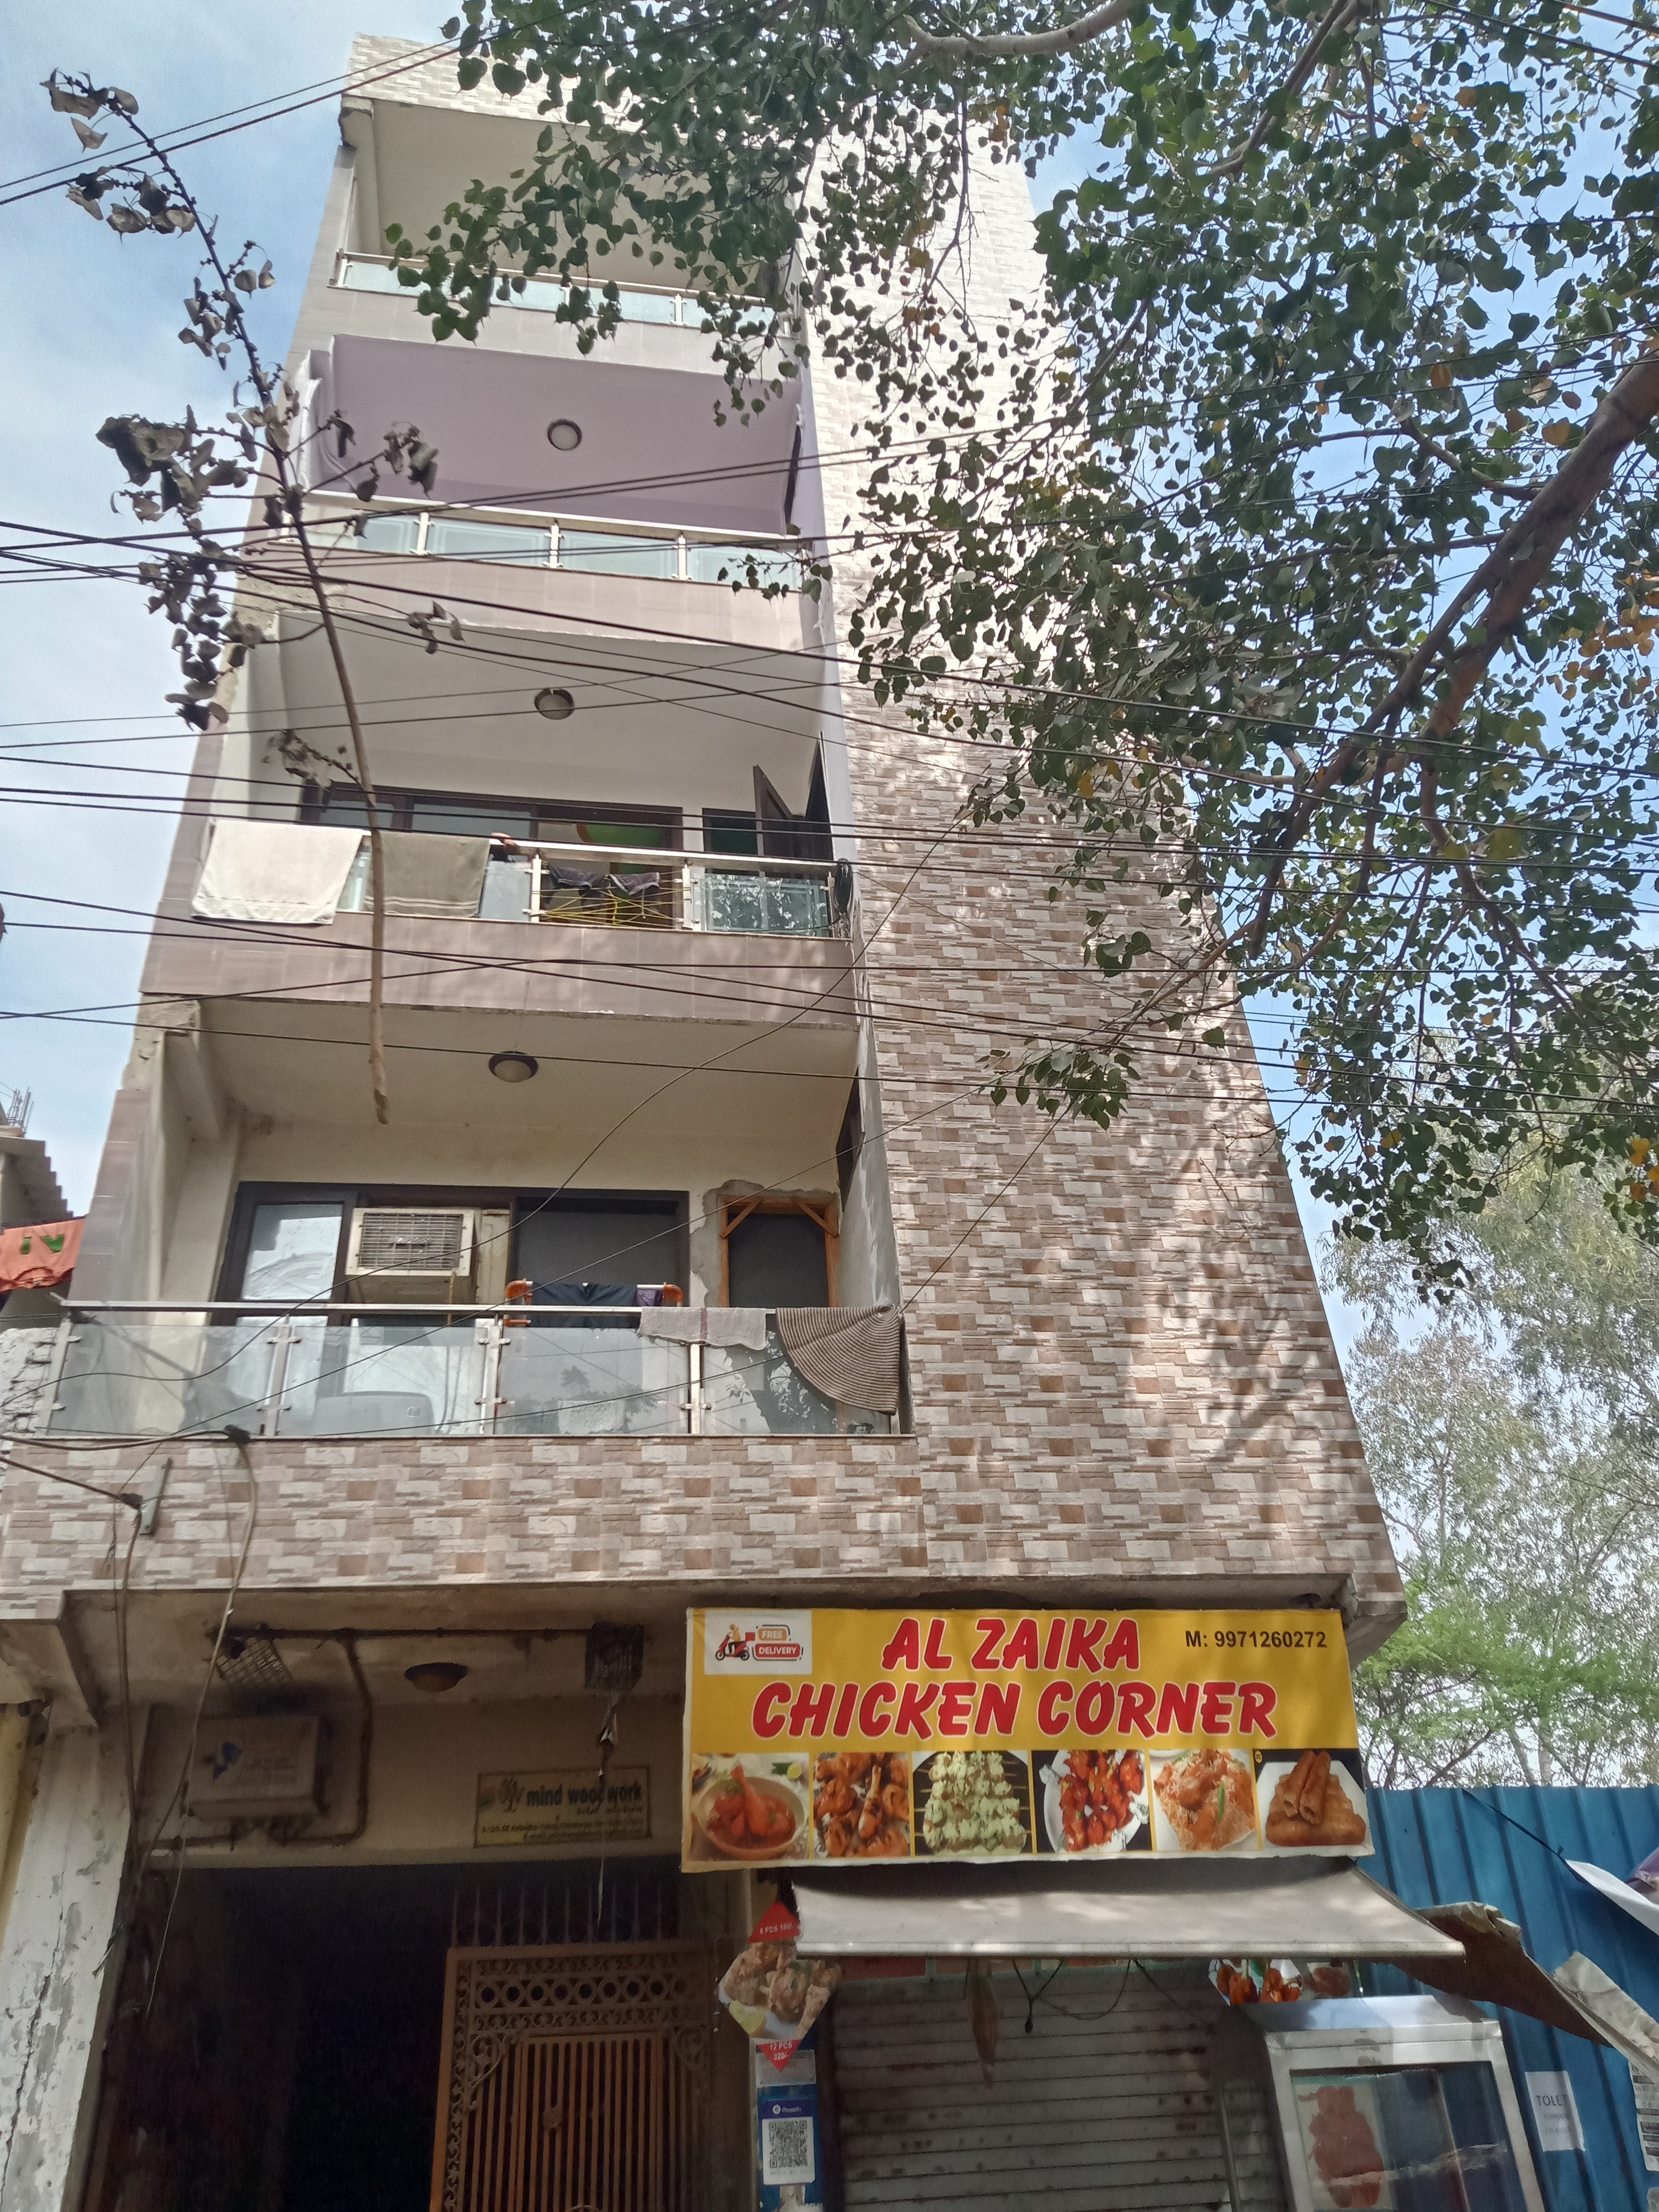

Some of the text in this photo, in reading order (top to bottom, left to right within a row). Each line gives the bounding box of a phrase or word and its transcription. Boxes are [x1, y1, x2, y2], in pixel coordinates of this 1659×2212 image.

[761, 1630, 783, 1639] FREE
[1185, 1630, 1327, 1648] M: 9971260272
[881, 1617, 1140, 1674] AL ZAIKA
[758, 1646, 797, 1655] DELIVERY
[751, 1680, 1278, 1741] CHICKEN CORNER
[765, 1925, 778, 1934] PCS
[778, 2041, 793, 2050] PCS
[773, 2052, 789, 2061] 320/-
